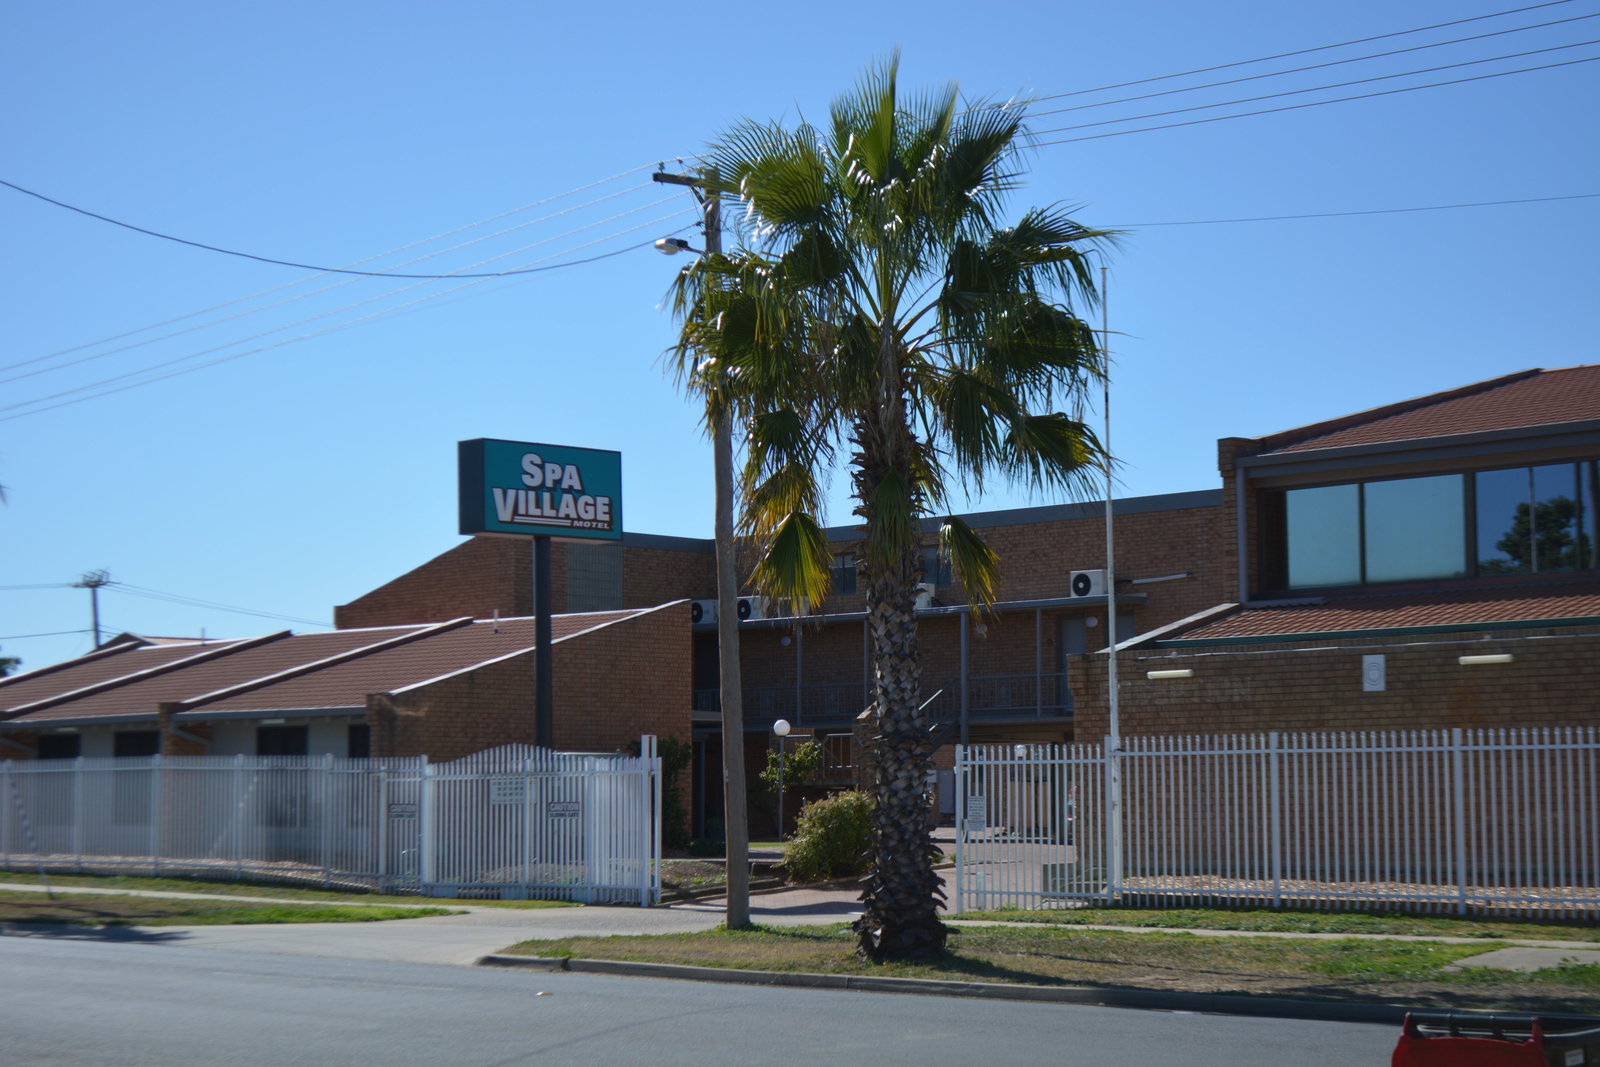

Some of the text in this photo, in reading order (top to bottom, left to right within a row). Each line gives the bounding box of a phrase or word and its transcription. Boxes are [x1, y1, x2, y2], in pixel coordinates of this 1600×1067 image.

[521, 452, 582, 490] SPA
[492, 487, 610, 522] VILLAGE
[573, 520, 610, 529] MOTEL
